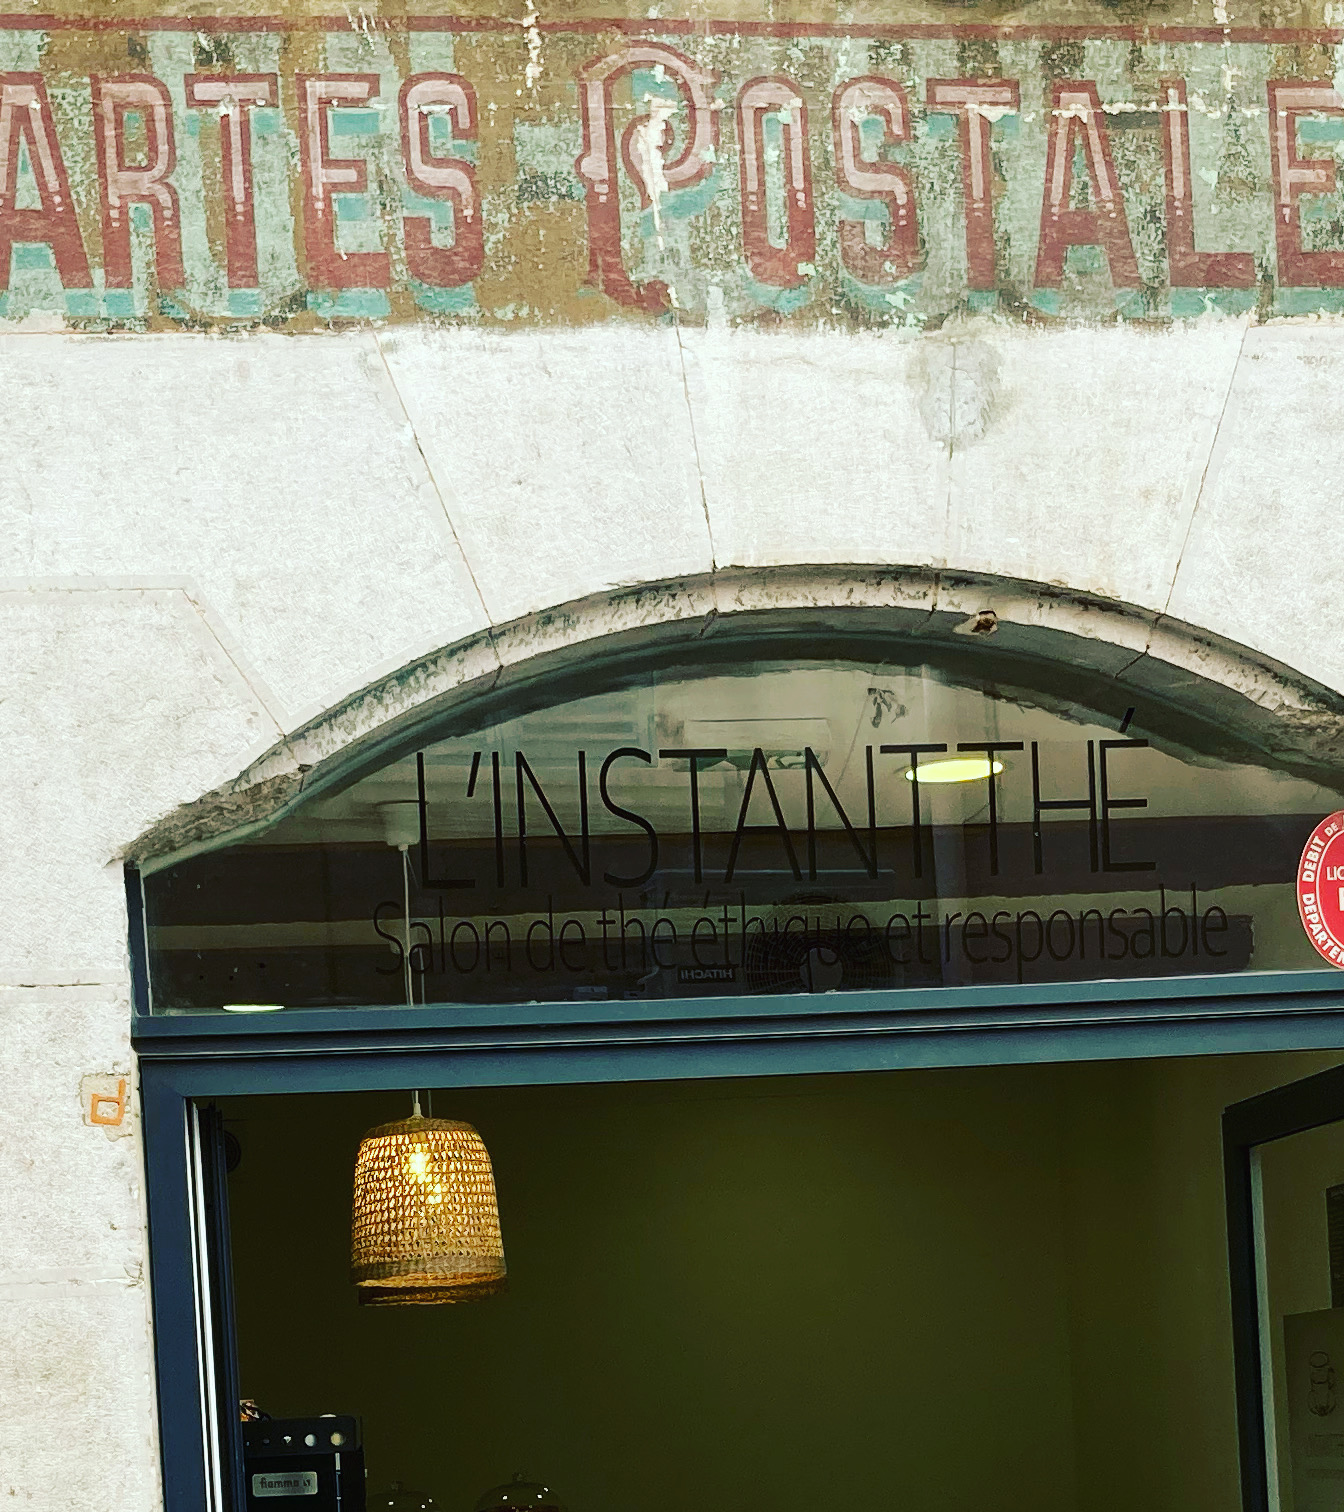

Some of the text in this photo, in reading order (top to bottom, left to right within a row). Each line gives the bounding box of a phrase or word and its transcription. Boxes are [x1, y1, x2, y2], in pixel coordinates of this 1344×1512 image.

[1302, 836, 1325, 882] DEBIT
[1325, 822, 1338, 836] DE
[372, 894, 513, 976] Salon
[527, 894, 587, 973] de
[885, 900, 932, 966] et
[943, 882, 1230, 986] responsable
